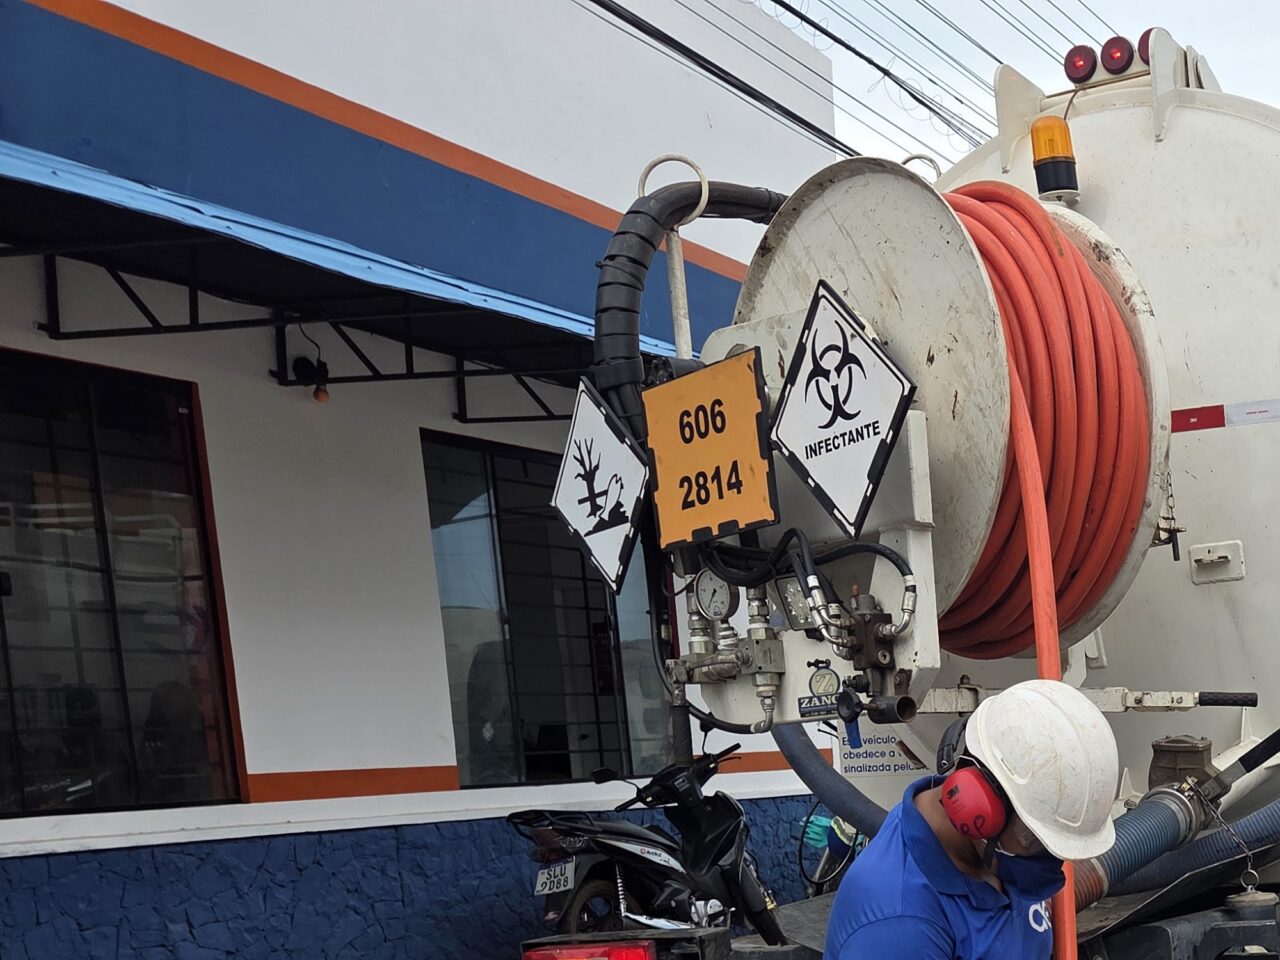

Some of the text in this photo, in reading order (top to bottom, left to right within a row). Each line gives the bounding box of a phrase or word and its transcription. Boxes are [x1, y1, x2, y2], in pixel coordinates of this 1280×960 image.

[678, 398, 727, 444] 606
[804, 420, 881, 460] INFECTANTE
[678, 460, 743, 510] 2814
[862, 734, 897, 745] veículo
[842, 750, 886, 760] obedece
[888, 750, 896, 758] a
[843, 764, 893, 774] sinalizada
